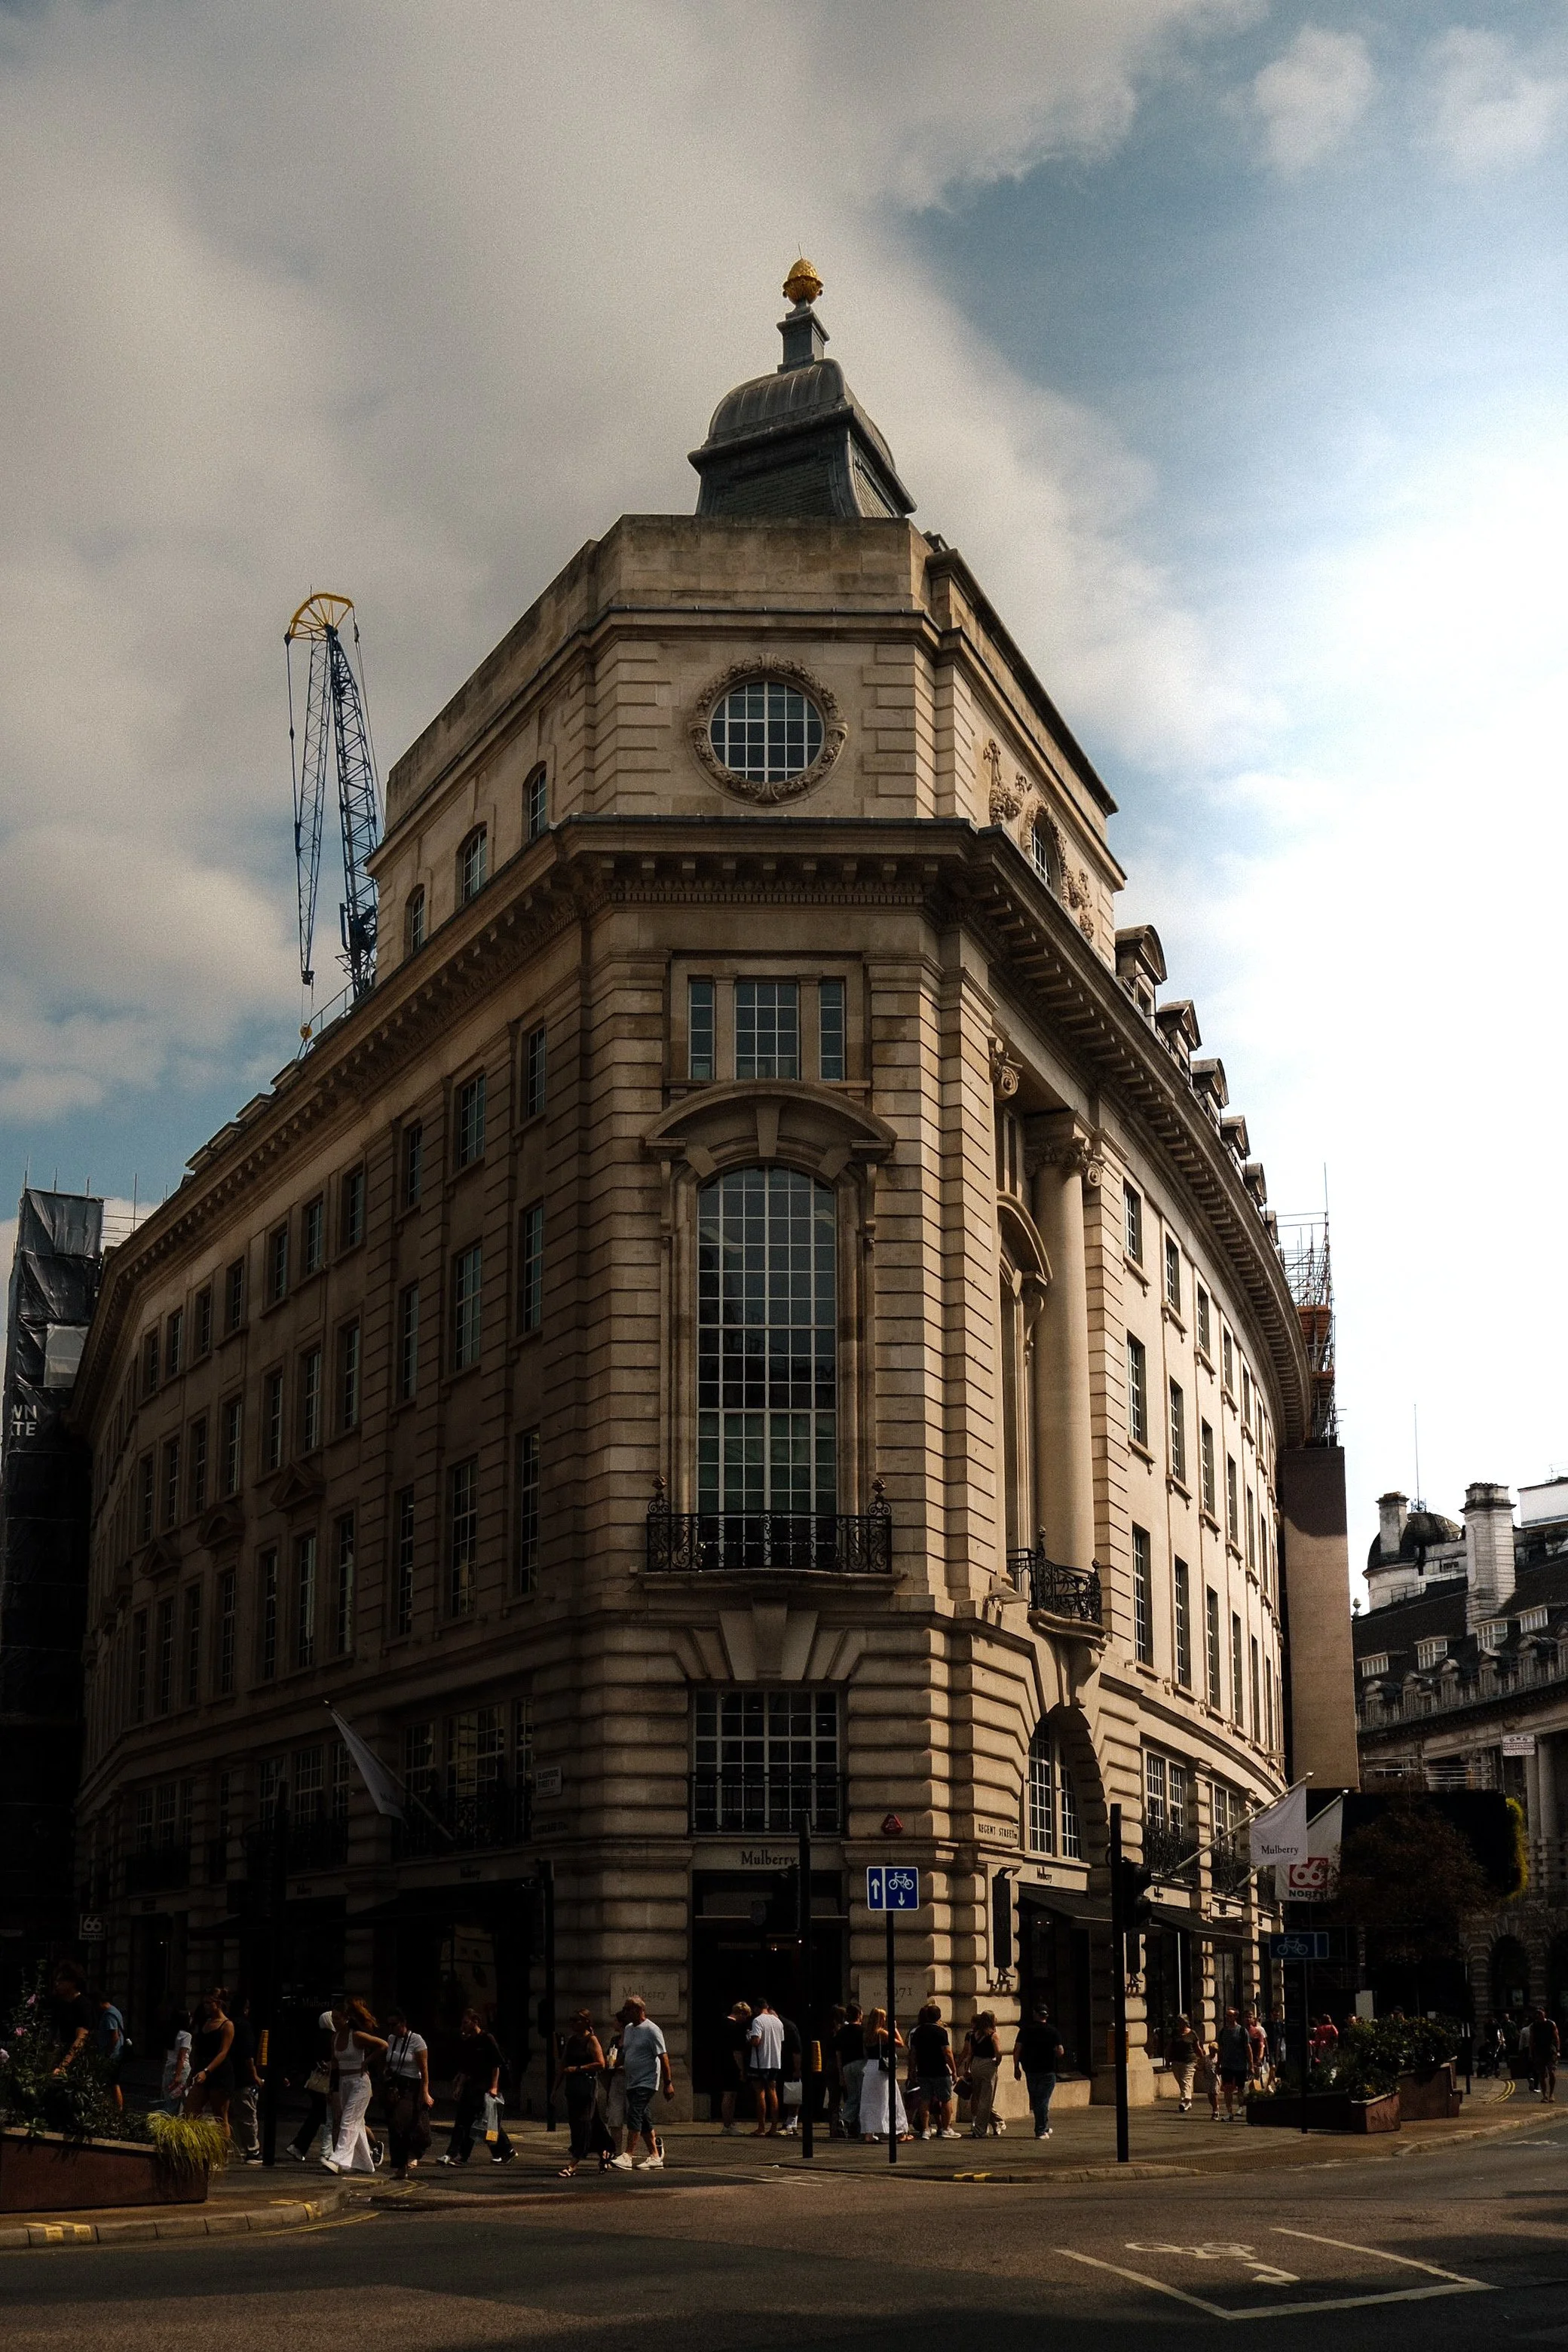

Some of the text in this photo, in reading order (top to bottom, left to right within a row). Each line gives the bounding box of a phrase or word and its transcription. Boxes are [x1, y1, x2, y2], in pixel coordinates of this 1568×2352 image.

[978, 1824, 996, 1835] REGENT
[999, 1828, 1014, 1839] STREET
[742, 1849, 798, 1865] Mulberry
[1261, 1845, 1299, 1855] Mulberry
